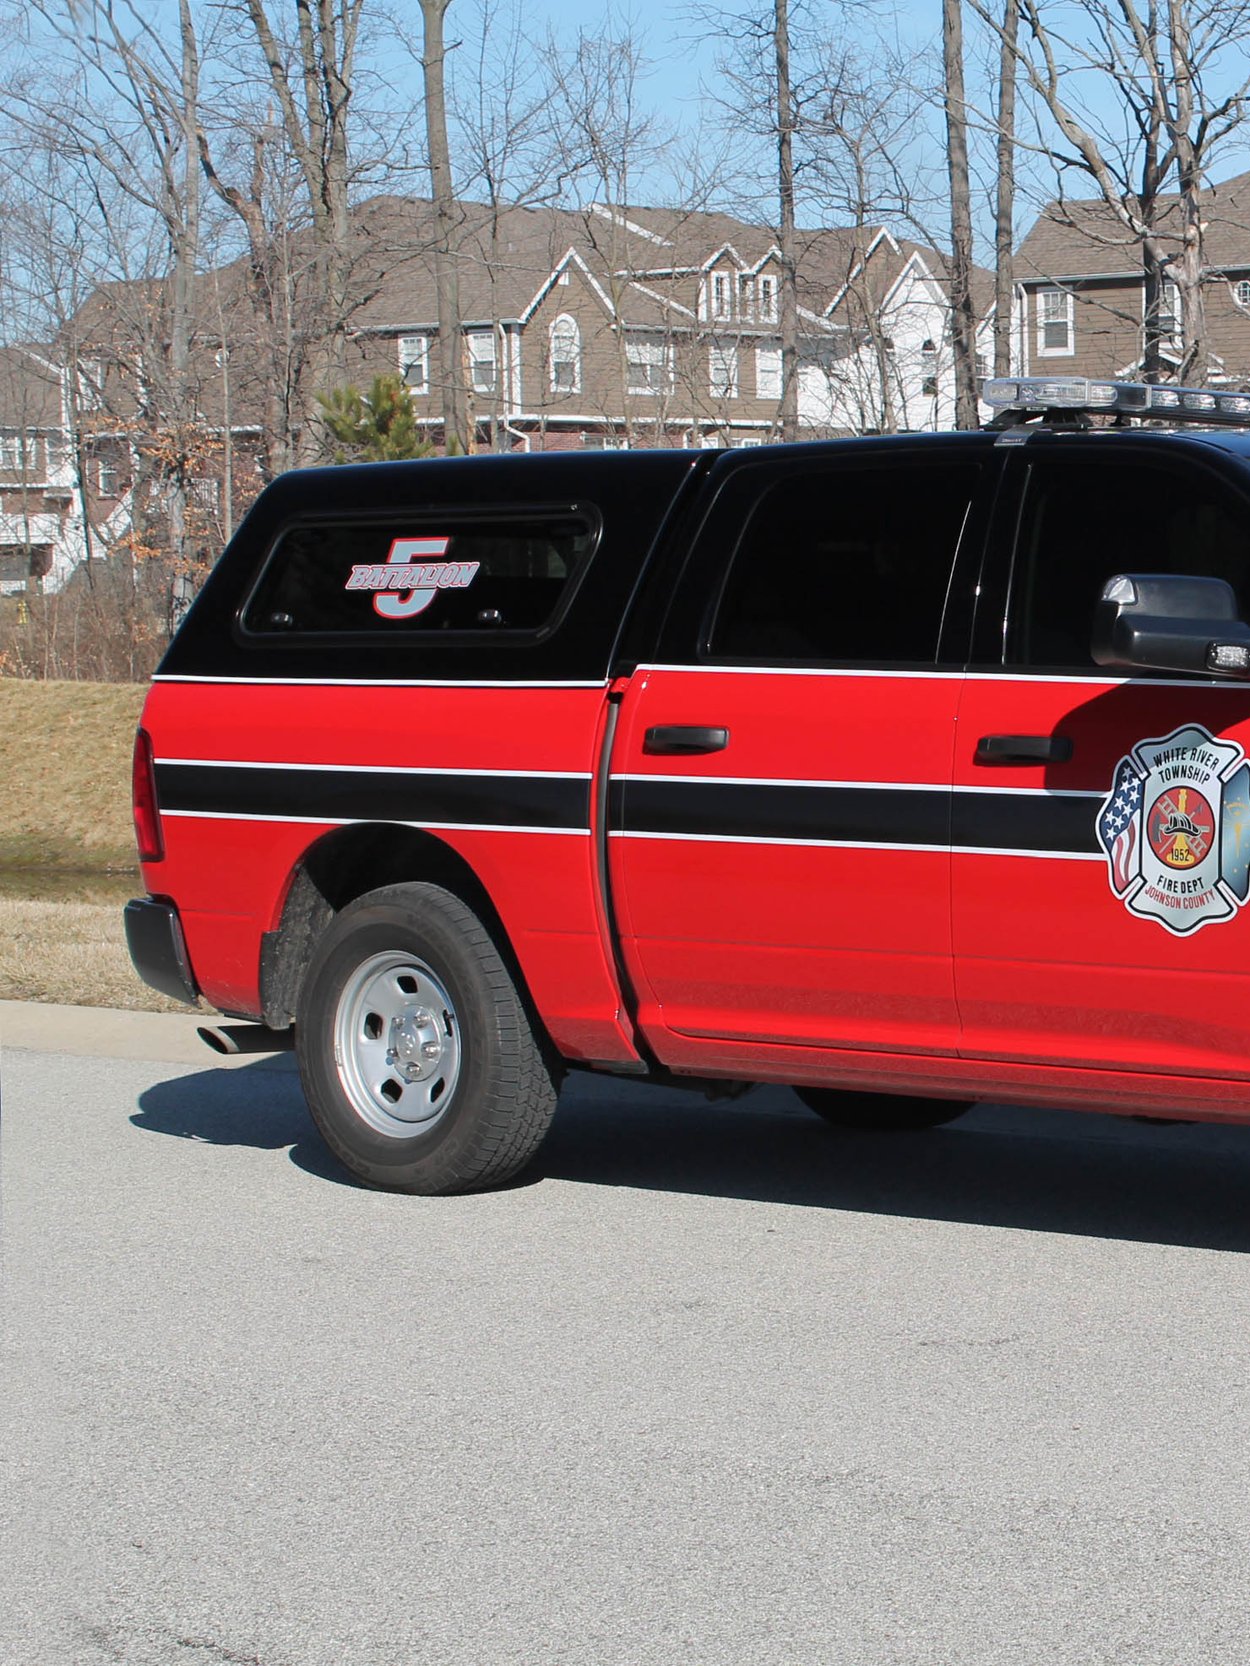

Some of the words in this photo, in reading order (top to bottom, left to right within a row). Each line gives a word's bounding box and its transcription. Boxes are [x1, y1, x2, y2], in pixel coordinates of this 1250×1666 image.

[345, 561, 480, 590] BATTALION
[373, 536, 450, 619] 5
[1153, 747, 1188, 769] WHITE
[1189, 747, 1220, 769] RIVER
[1158, 765, 1211, 785] TOWNSHIP
[1170, 848, 1190, 862] 1952
[1157, 875, 1179, 894] FIRE
[1180, 876, 1205, 894] DEPT
[1144, 885, 1182, 910] JOHNSON
[1183, 888, 1216, 910] COUNTY
